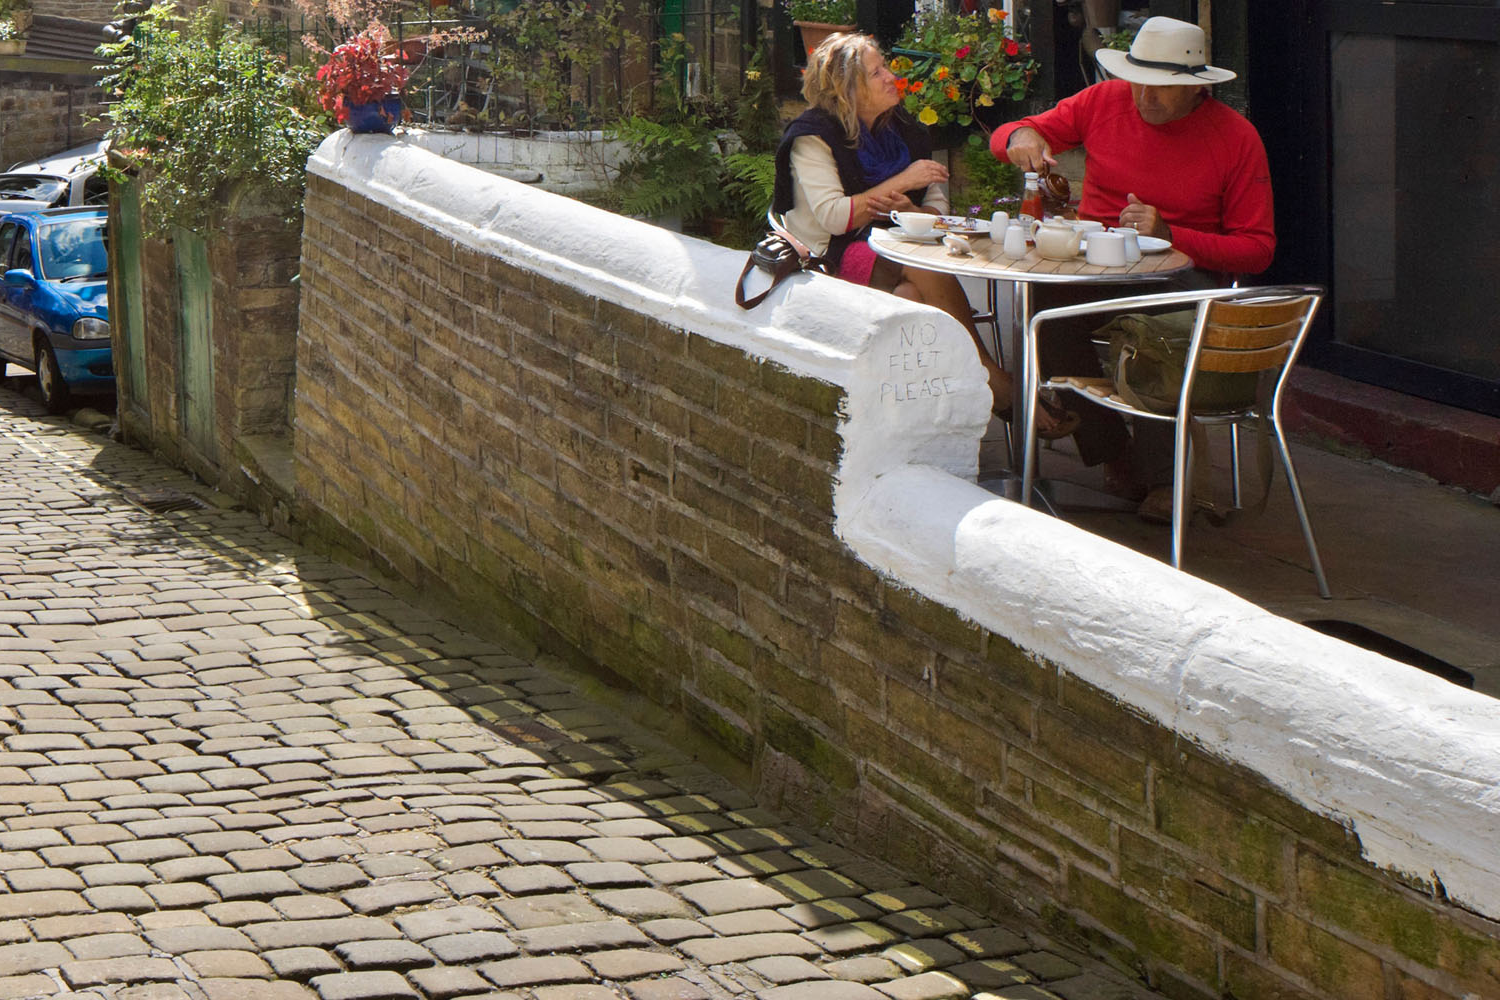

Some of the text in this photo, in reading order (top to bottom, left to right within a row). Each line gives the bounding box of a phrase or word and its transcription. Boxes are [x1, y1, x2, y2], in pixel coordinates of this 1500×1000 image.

[900, 323, 938, 348] NO
[889, 351, 941, 374] FEET
[881, 376, 957, 403] PLEASE
